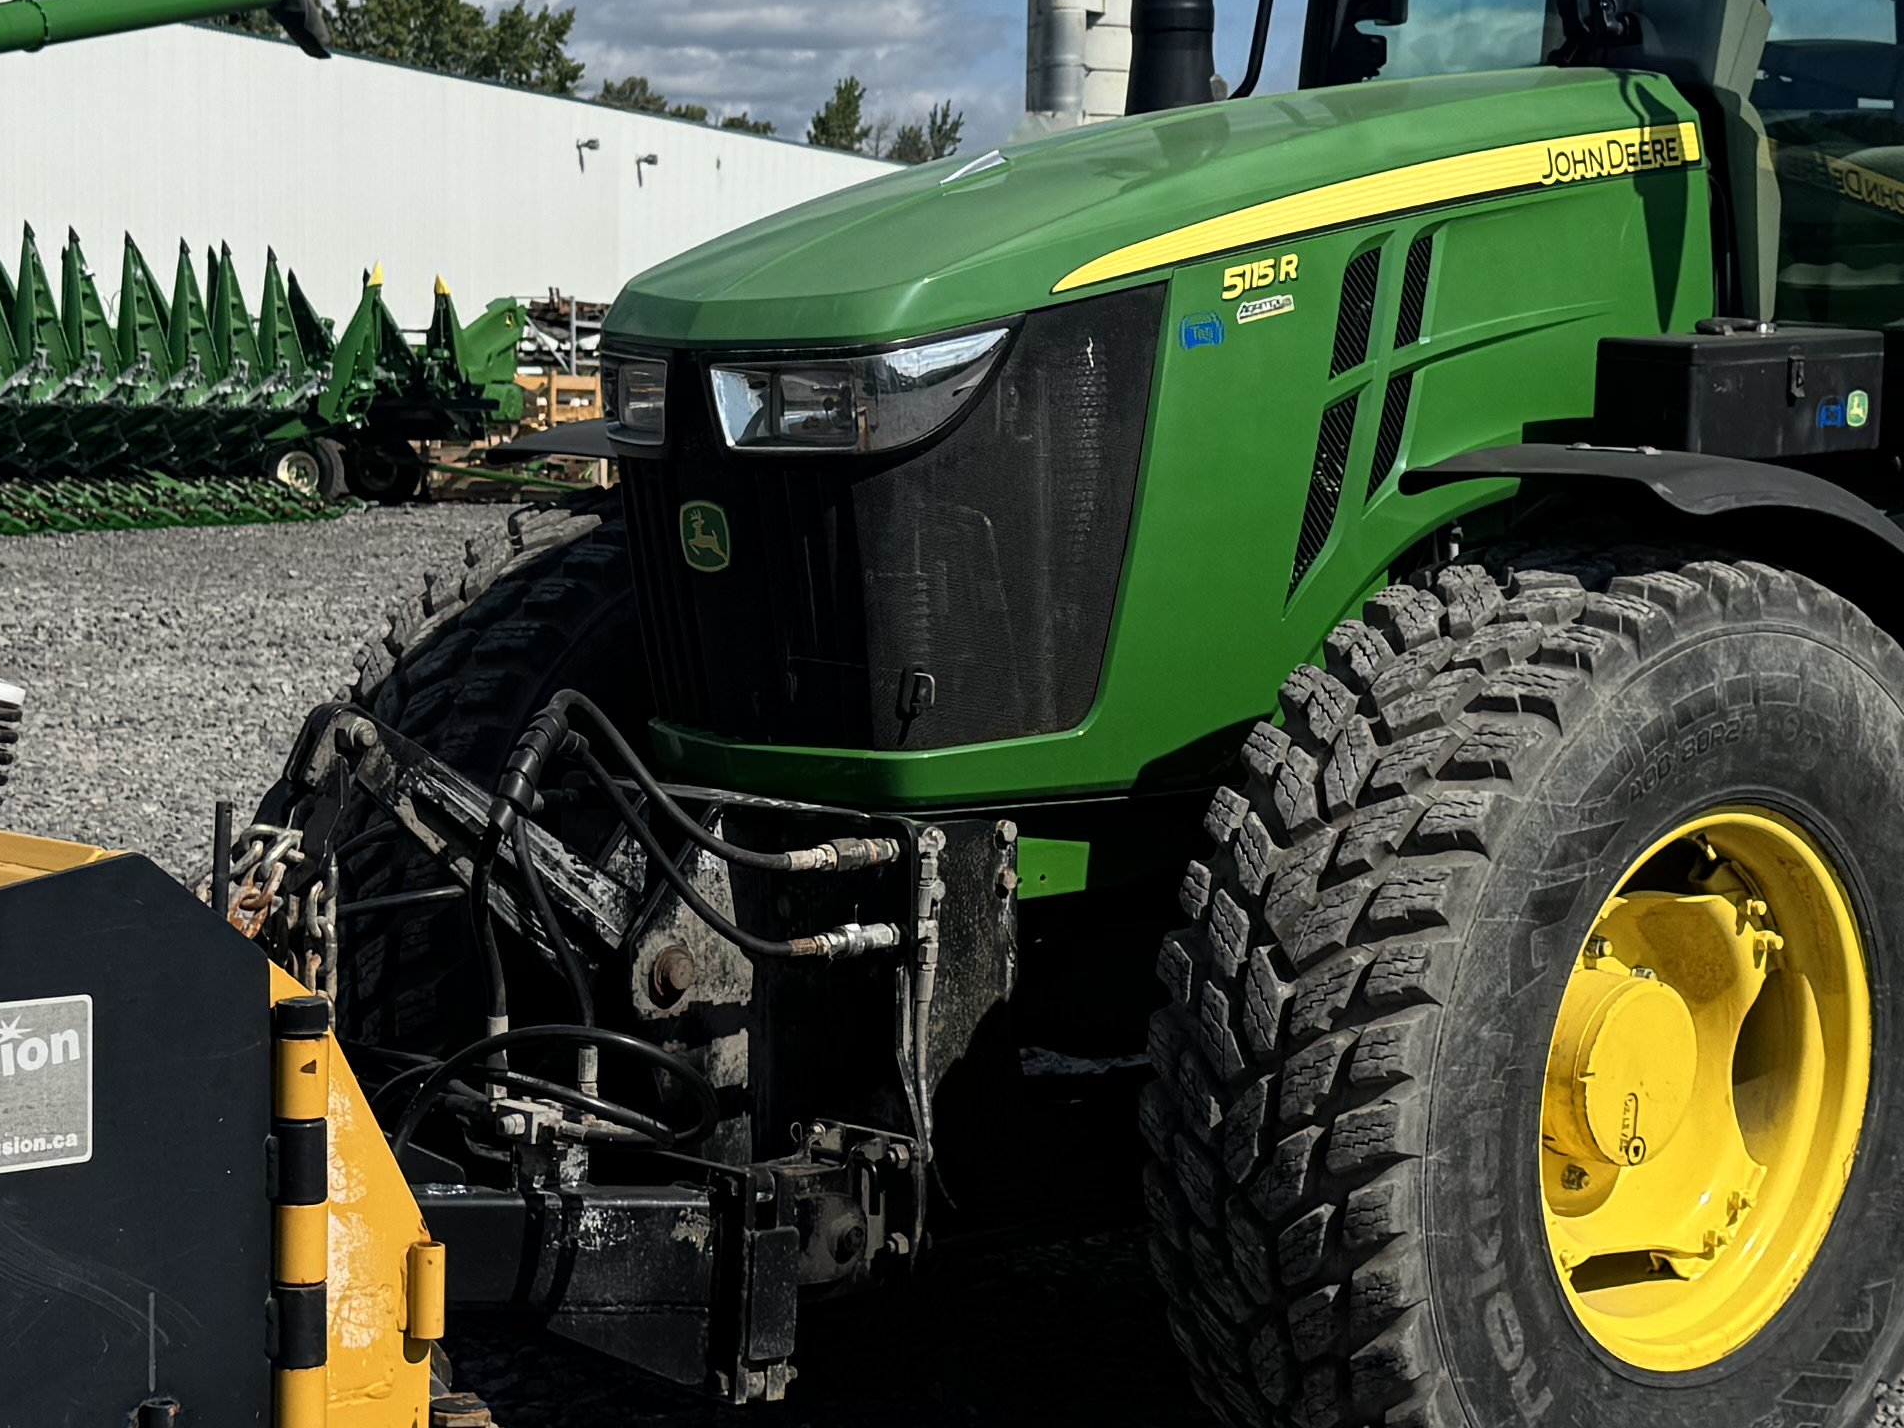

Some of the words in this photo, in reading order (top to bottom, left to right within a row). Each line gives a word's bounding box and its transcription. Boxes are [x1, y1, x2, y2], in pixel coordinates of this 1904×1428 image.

[1542, 146, 1605, 180] JOHN
[1607, 137, 1680, 170] DEERE
[1221, 259, 1275, 300] 5115
